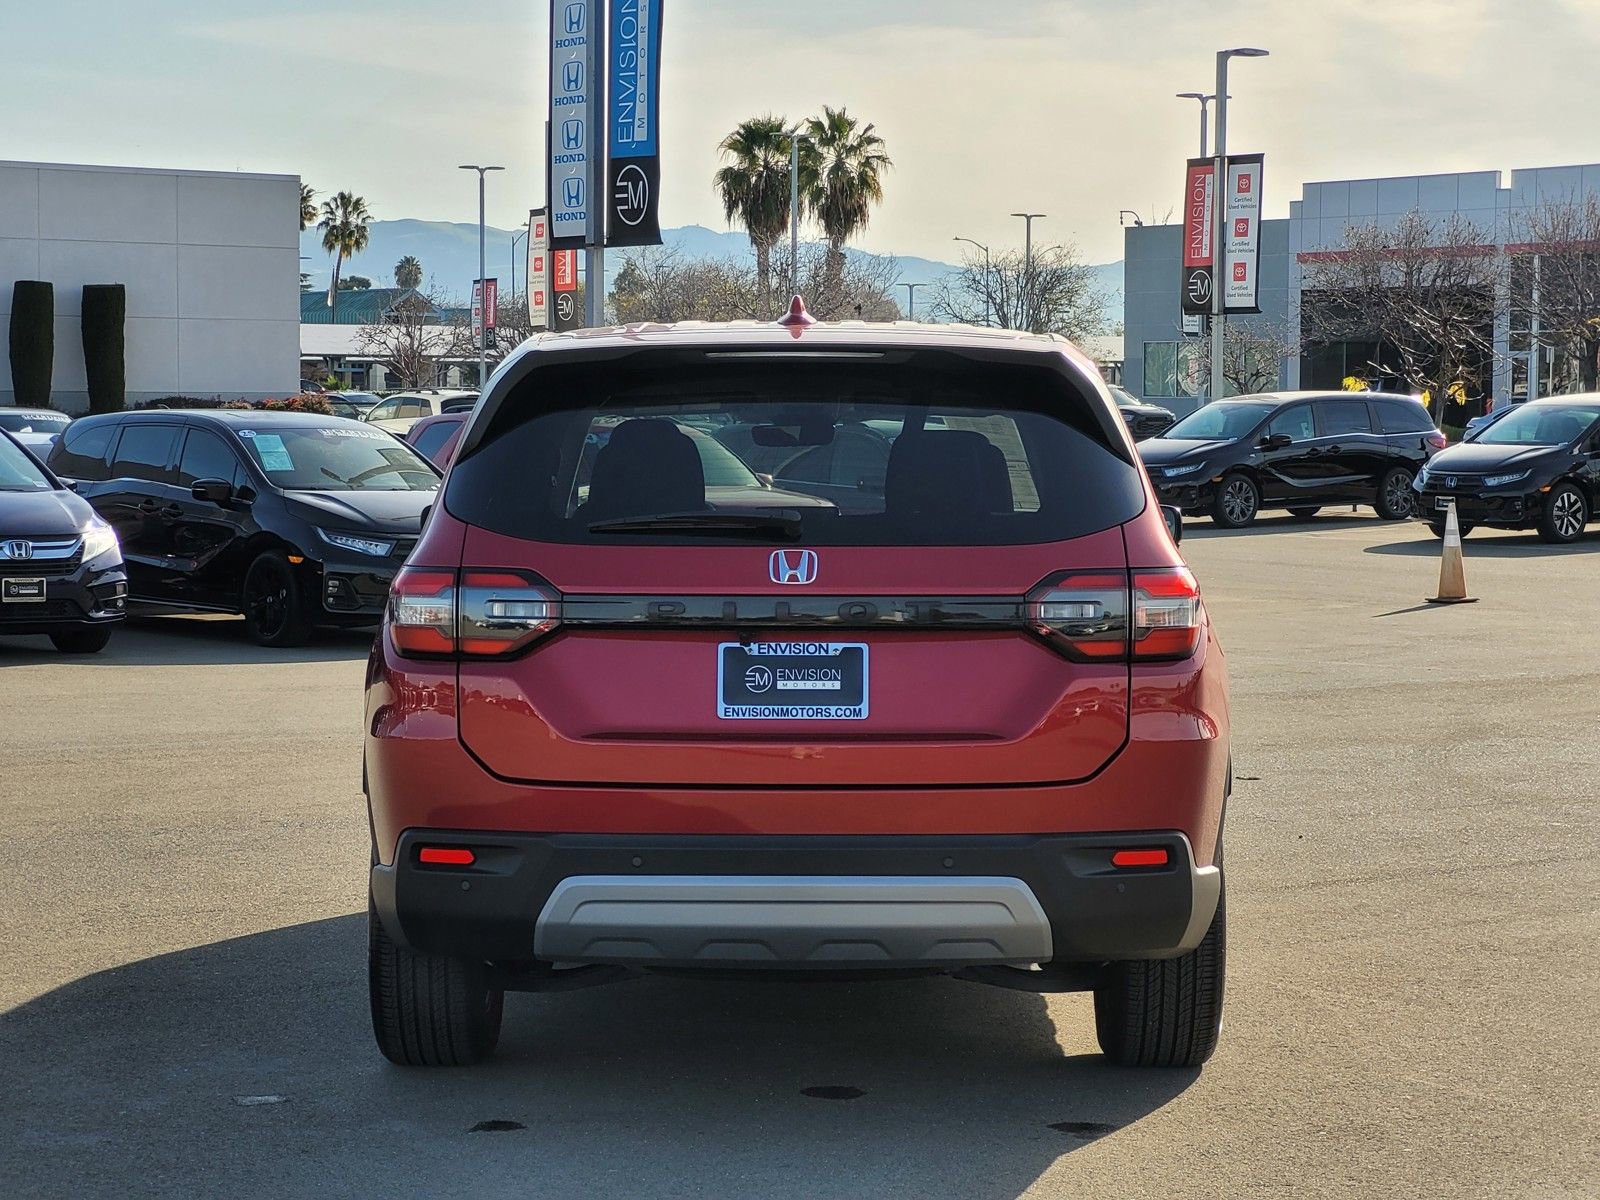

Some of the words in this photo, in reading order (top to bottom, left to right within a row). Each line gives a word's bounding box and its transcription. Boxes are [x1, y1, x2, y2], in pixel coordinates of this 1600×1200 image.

[555, 36, 587, 49] HOND
[618, 0, 637, 143] ENVISION
[637, 4, 647, 129] MOTORS
[554, 95, 587, 107] HOND
[554, 153, 587, 164] HOND
[555, 211, 587, 222] HOND
[1191, 174, 1205, 259] ENVISION
[557, 251, 566, 285] ENVI
[648, 600, 944, 622] PILOT
[757, 643, 829, 655] ENVISION
[776, 668, 842, 681] ENVISION
[723, 706, 863, 718] ENVISIONMOTORS.COM
